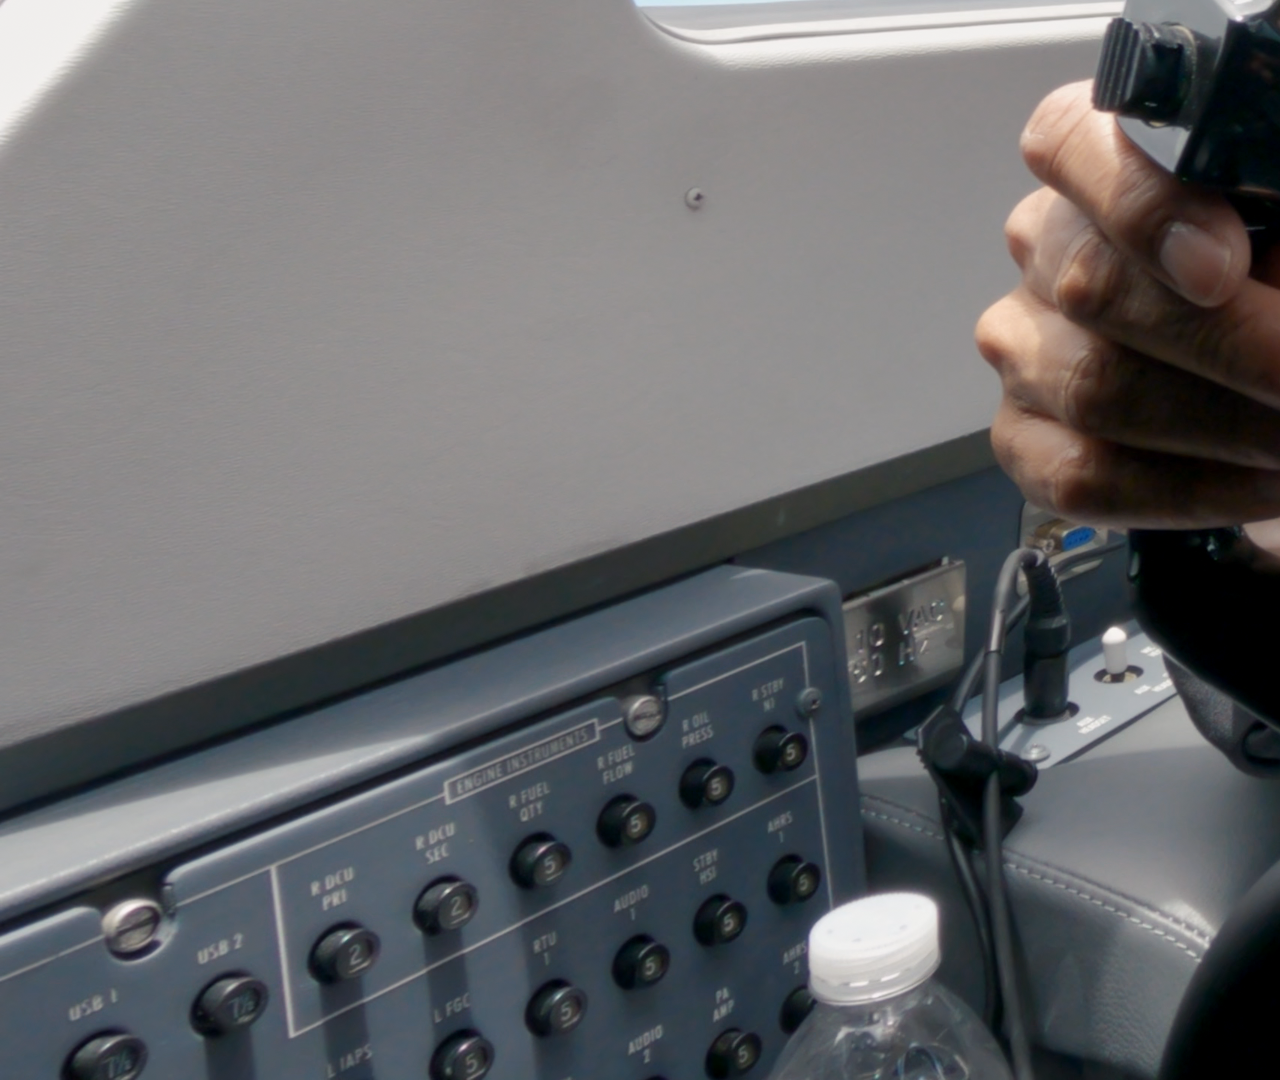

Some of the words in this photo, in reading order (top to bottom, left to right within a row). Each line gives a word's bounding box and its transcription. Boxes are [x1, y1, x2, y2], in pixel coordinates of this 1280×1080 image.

[752, 688, 760, 701] R
[761, 677, 785, 697] STBY
[682, 718, 690, 732] R
[692, 710, 710, 727] OIL
[682, 724, 715, 749] PRESS
[456, 763, 503, 796] ENGINE
[506, 728, 589, 775] INSTRUMENTS
[597, 756, 605, 770] R
[607, 744, 635, 766] FUEL
[784, 744, 796, 760] 5
[602, 761, 634, 785] FLOW
[509, 795, 517, 809] R
[520, 781, 551, 804] FUEL
[709, 777, 722, 795] 5
[519, 800, 544, 822] QTY
[767, 811, 793, 833] AHRS
[630, 814, 642, 832] 5
[415, 835, 425, 850] R
[429, 822, 456, 845] DCU
[425, 844, 449, 865] SEC
[544, 854, 556, 874] 5
[692, 848, 719, 872] STBY
[311, 881, 320, 896] R
[325, 866, 355, 890] DCU
[799, 874, 810, 891] 5
[322, 888, 347, 911] PRI
[450, 896, 462, 916] 2
[613, 883, 649, 914] AUDIO
[723, 913, 734, 931] 5
[197, 939, 229, 964] USB
[232, 932, 243, 950] 2
[533, 931, 558, 954] RTU
[349, 944, 361, 965] 2
[644, 957, 656, 976] 5
[716, 986, 730, 1004] PA
[68, 997, 103, 1021] USB
[433, 1008, 443, 1023] L
[445, 992, 471, 1017] FGC
[560, 1001, 572, 1020] 5
[713, 998, 736, 1023] AMP
[627, 1024, 664, 1056] AUDIO
[327, 1064, 336, 1079] L
[340, 1045, 373, 1072] IAPS
[465, 1053, 478, 1072] 5
[643, 1051, 651, 1064] 2
[738, 1045, 749, 1063] 5
